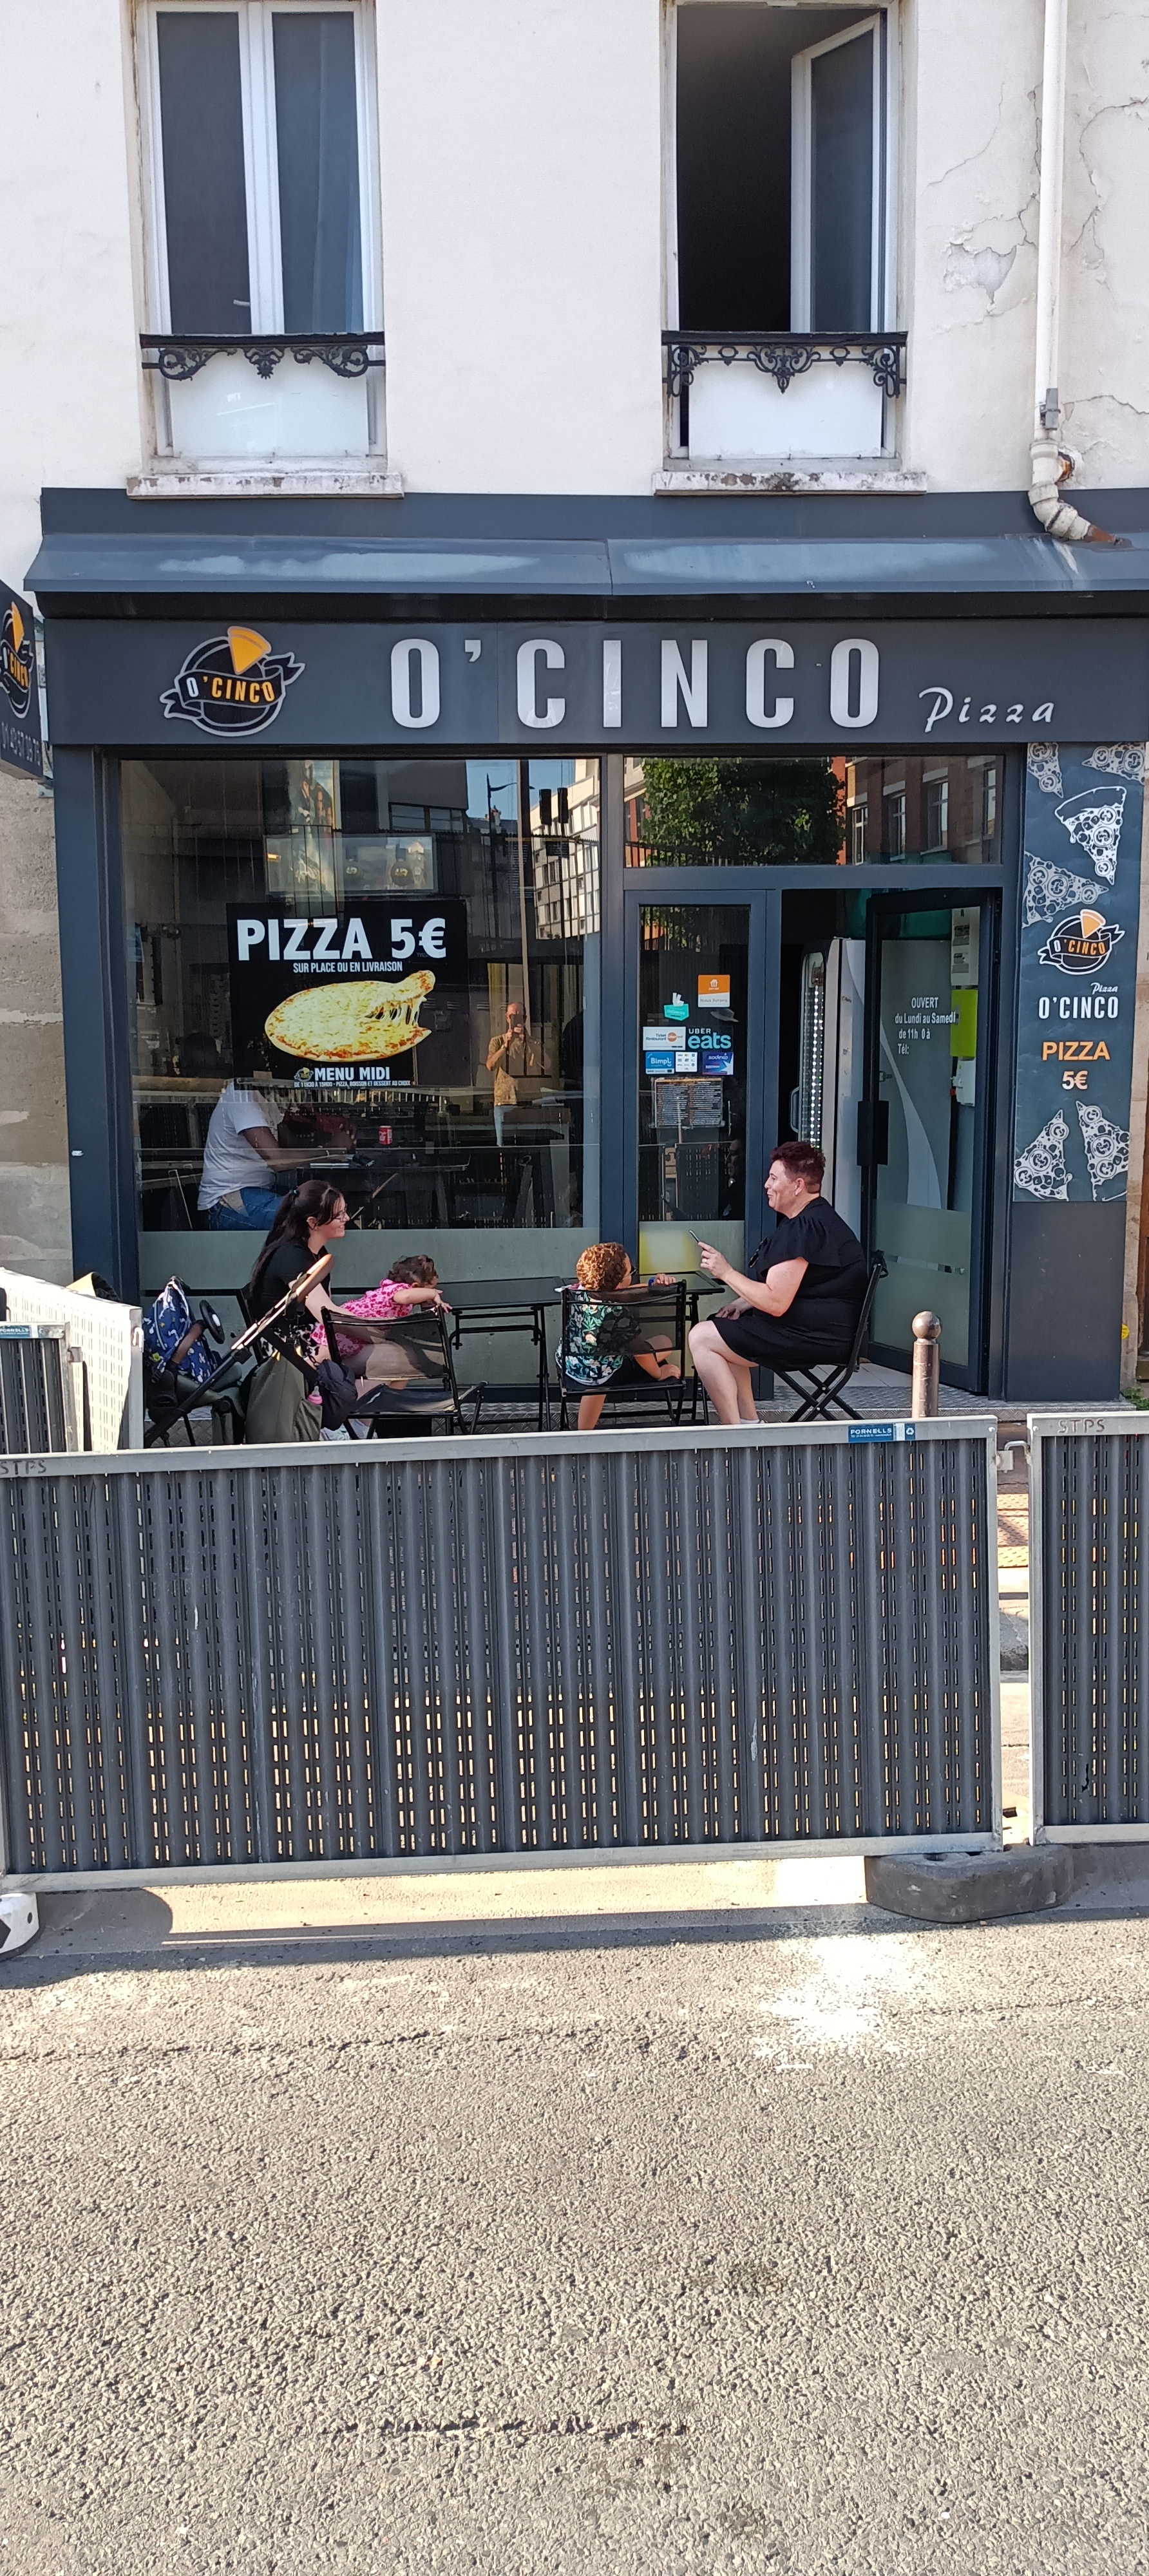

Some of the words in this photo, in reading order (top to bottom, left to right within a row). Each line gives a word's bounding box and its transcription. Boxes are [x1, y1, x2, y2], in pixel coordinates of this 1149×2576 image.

[3, 647, 29, 688] O'CINCO
[185, 676, 275, 703] O'CINCO
[389, 638, 879, 728] O'CINCO
[918, 687, 1054, 733] Pizza
[236, 918, 373, 961] PIZZA
[390, 917, 447, 960] 5€
[1053, 939, 1106, 956] O'CINCO
[293, 962, 309, 973] SUR
[311, 961, 336, 972] PLACE
[337, 961, 348, 972] OU
[350, 961, 361, 972] EN
[362, 961, 403, 972] LIVRAISON
[1090, 982, 1119, 994] Pizza
[911, 997, 939, 1009] OUVERT
[1038, 996, 1119, 1019] O'CINCO
[895, 1012, 903, 1024] du
[904, 1012, 922, 1024] Lundi
[922, 1015, 931, 1024] au
[931, 1011, 956, 1024] Samedi
[687, 1032, 732, 1049] eats
[898, 1028, 907, 1039] de
[926, 1028, 931, 1039] à
[1042, 1041, 1110, 1061] PIZZA
[314, 1067, 354, 1081] MENU
[359, 1066, 390, 1081] MIDI
[1061, 1070, 1088, 1090] 5€
[1058, 1418, 1105, 1434] STPS
